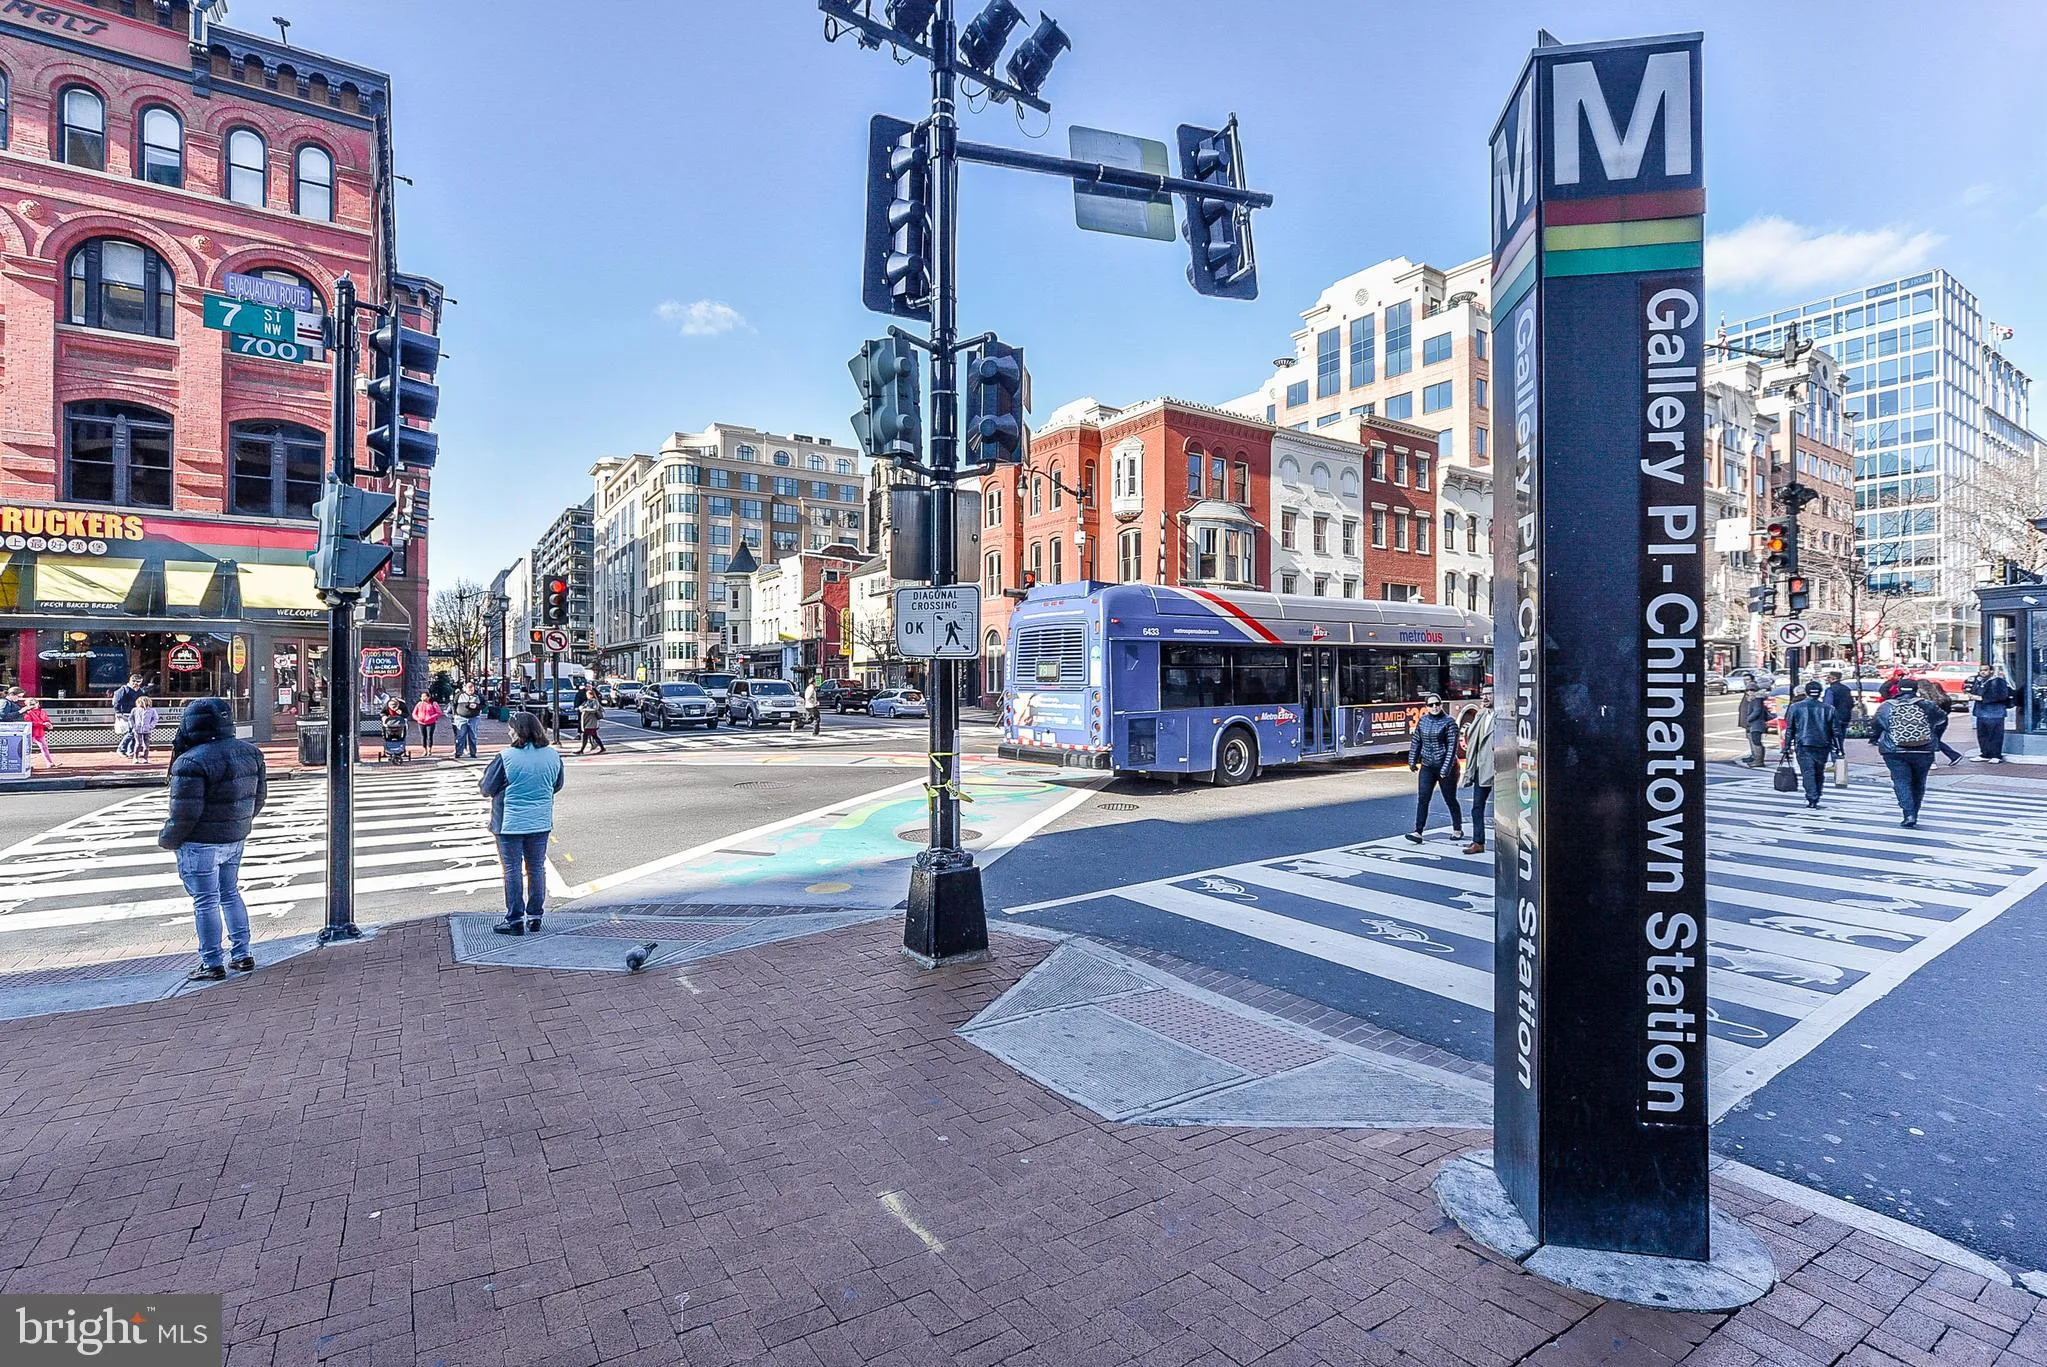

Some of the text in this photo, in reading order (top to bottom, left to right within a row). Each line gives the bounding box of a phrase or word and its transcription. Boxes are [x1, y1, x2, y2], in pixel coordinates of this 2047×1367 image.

[1553, 51, 1692, 186] M
[1493, 76, 1534, 250] M
[228, 275, 306, 307] EVACUATION ROUTE
[219, 301, 282, 327] 7 ST
[263, 321, 282, 336] NW
[238, 335, 298, 360] 700
[1515, 307, 1536, 496] Gallery
[2, 506, 144, 541] RUCKERS
[911, 601, 958, 610] CROSSING
[913, 590, 959, 600] DIAGONAL
[277, 609, 320, 617] WELCOME
[905, 621, 924, 635] OK
[1142, 627, 1160, 636] 6433
[1399, 629, 1443, 643] metrobus
[1640, 288, 1699, 1113] Gallery Pl-Chinatown Station
[1371, 710, 1406, 722] UNLIMITED
[1517, 897, 1537, 1091] Station
